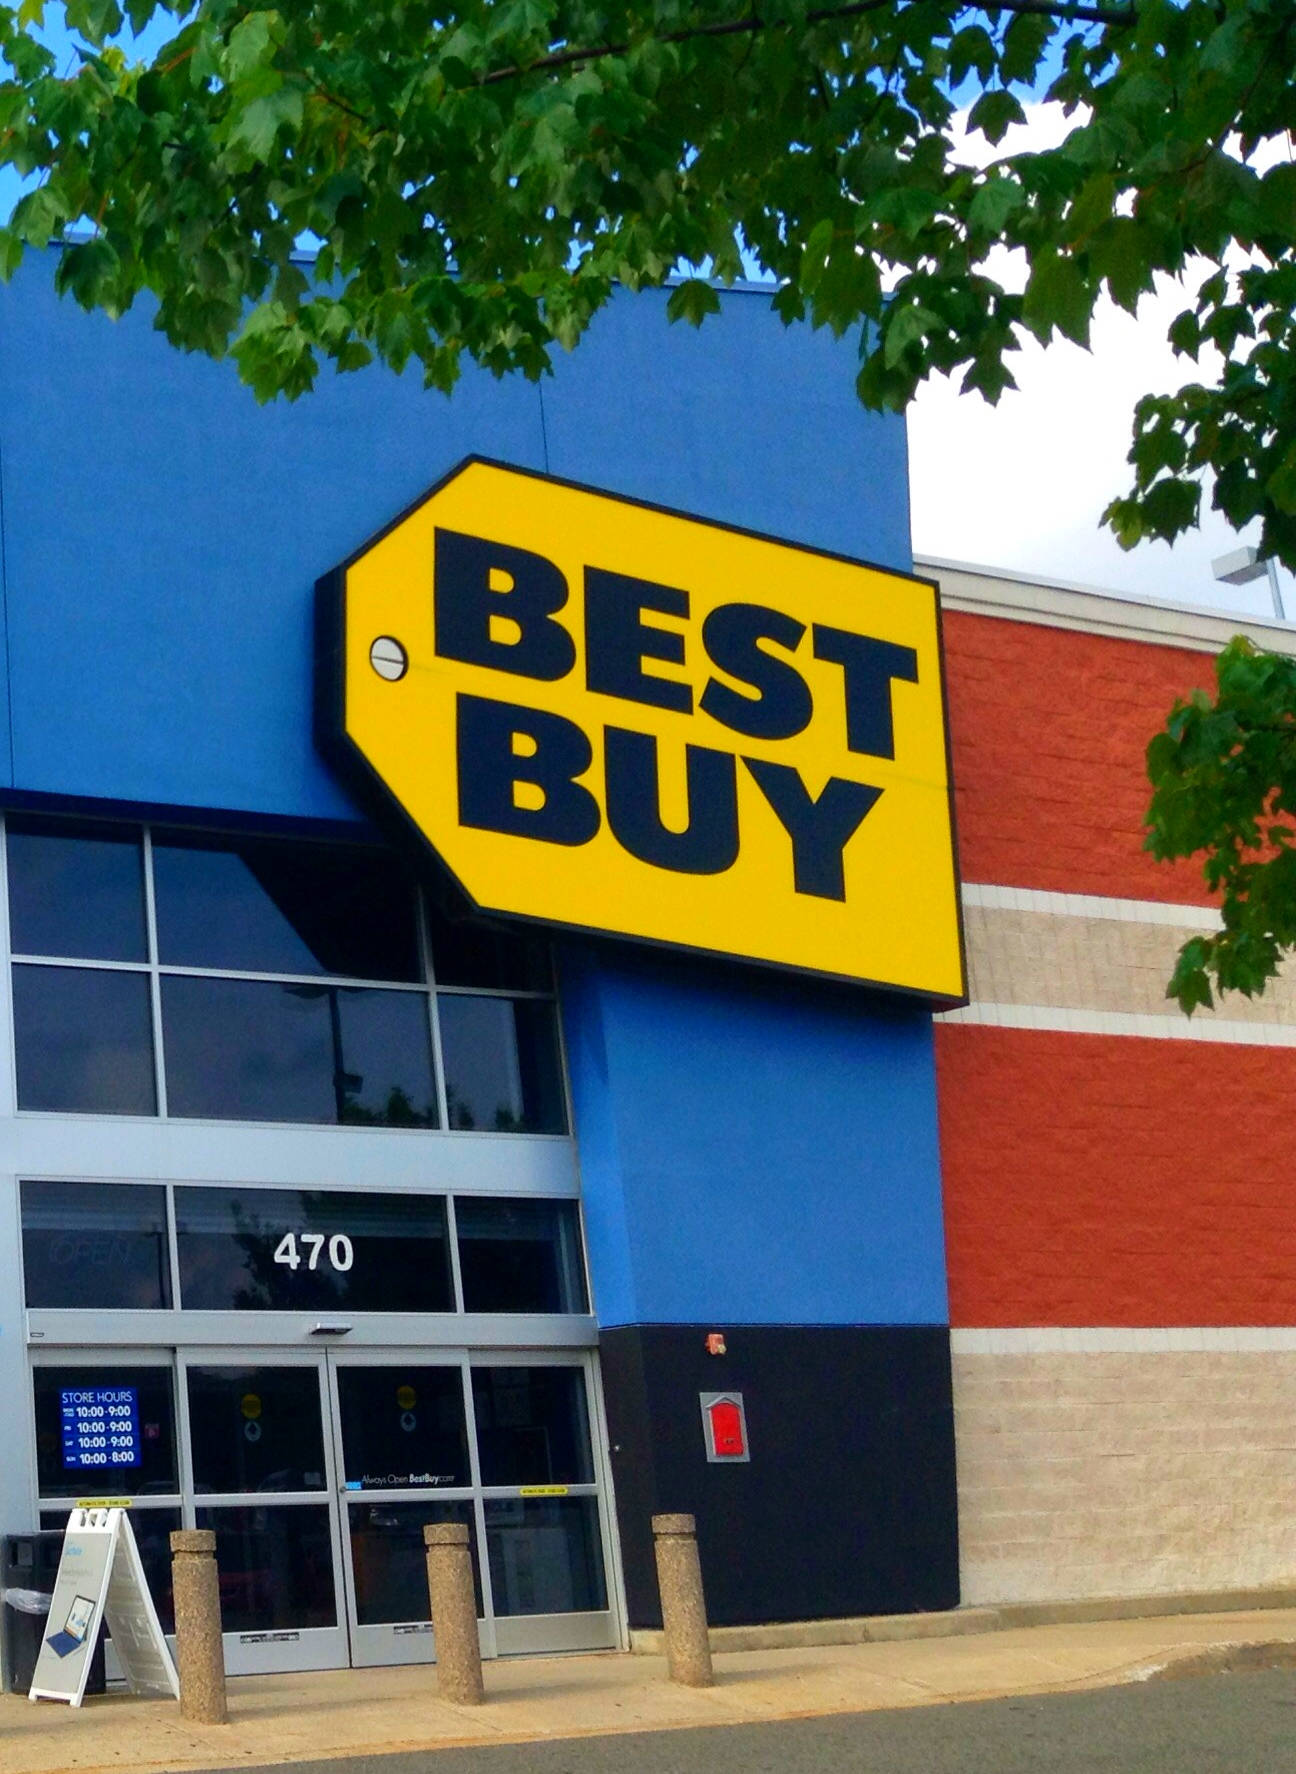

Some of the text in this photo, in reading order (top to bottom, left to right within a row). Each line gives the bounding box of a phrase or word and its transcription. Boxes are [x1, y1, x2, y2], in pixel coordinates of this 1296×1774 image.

[434, 525, 919, 760] BEST
[455, 691, 885, 903] BUY
[274, 1233, 354, 1271] 470
[62, 1391, 133, 1403] STORE HOURS
